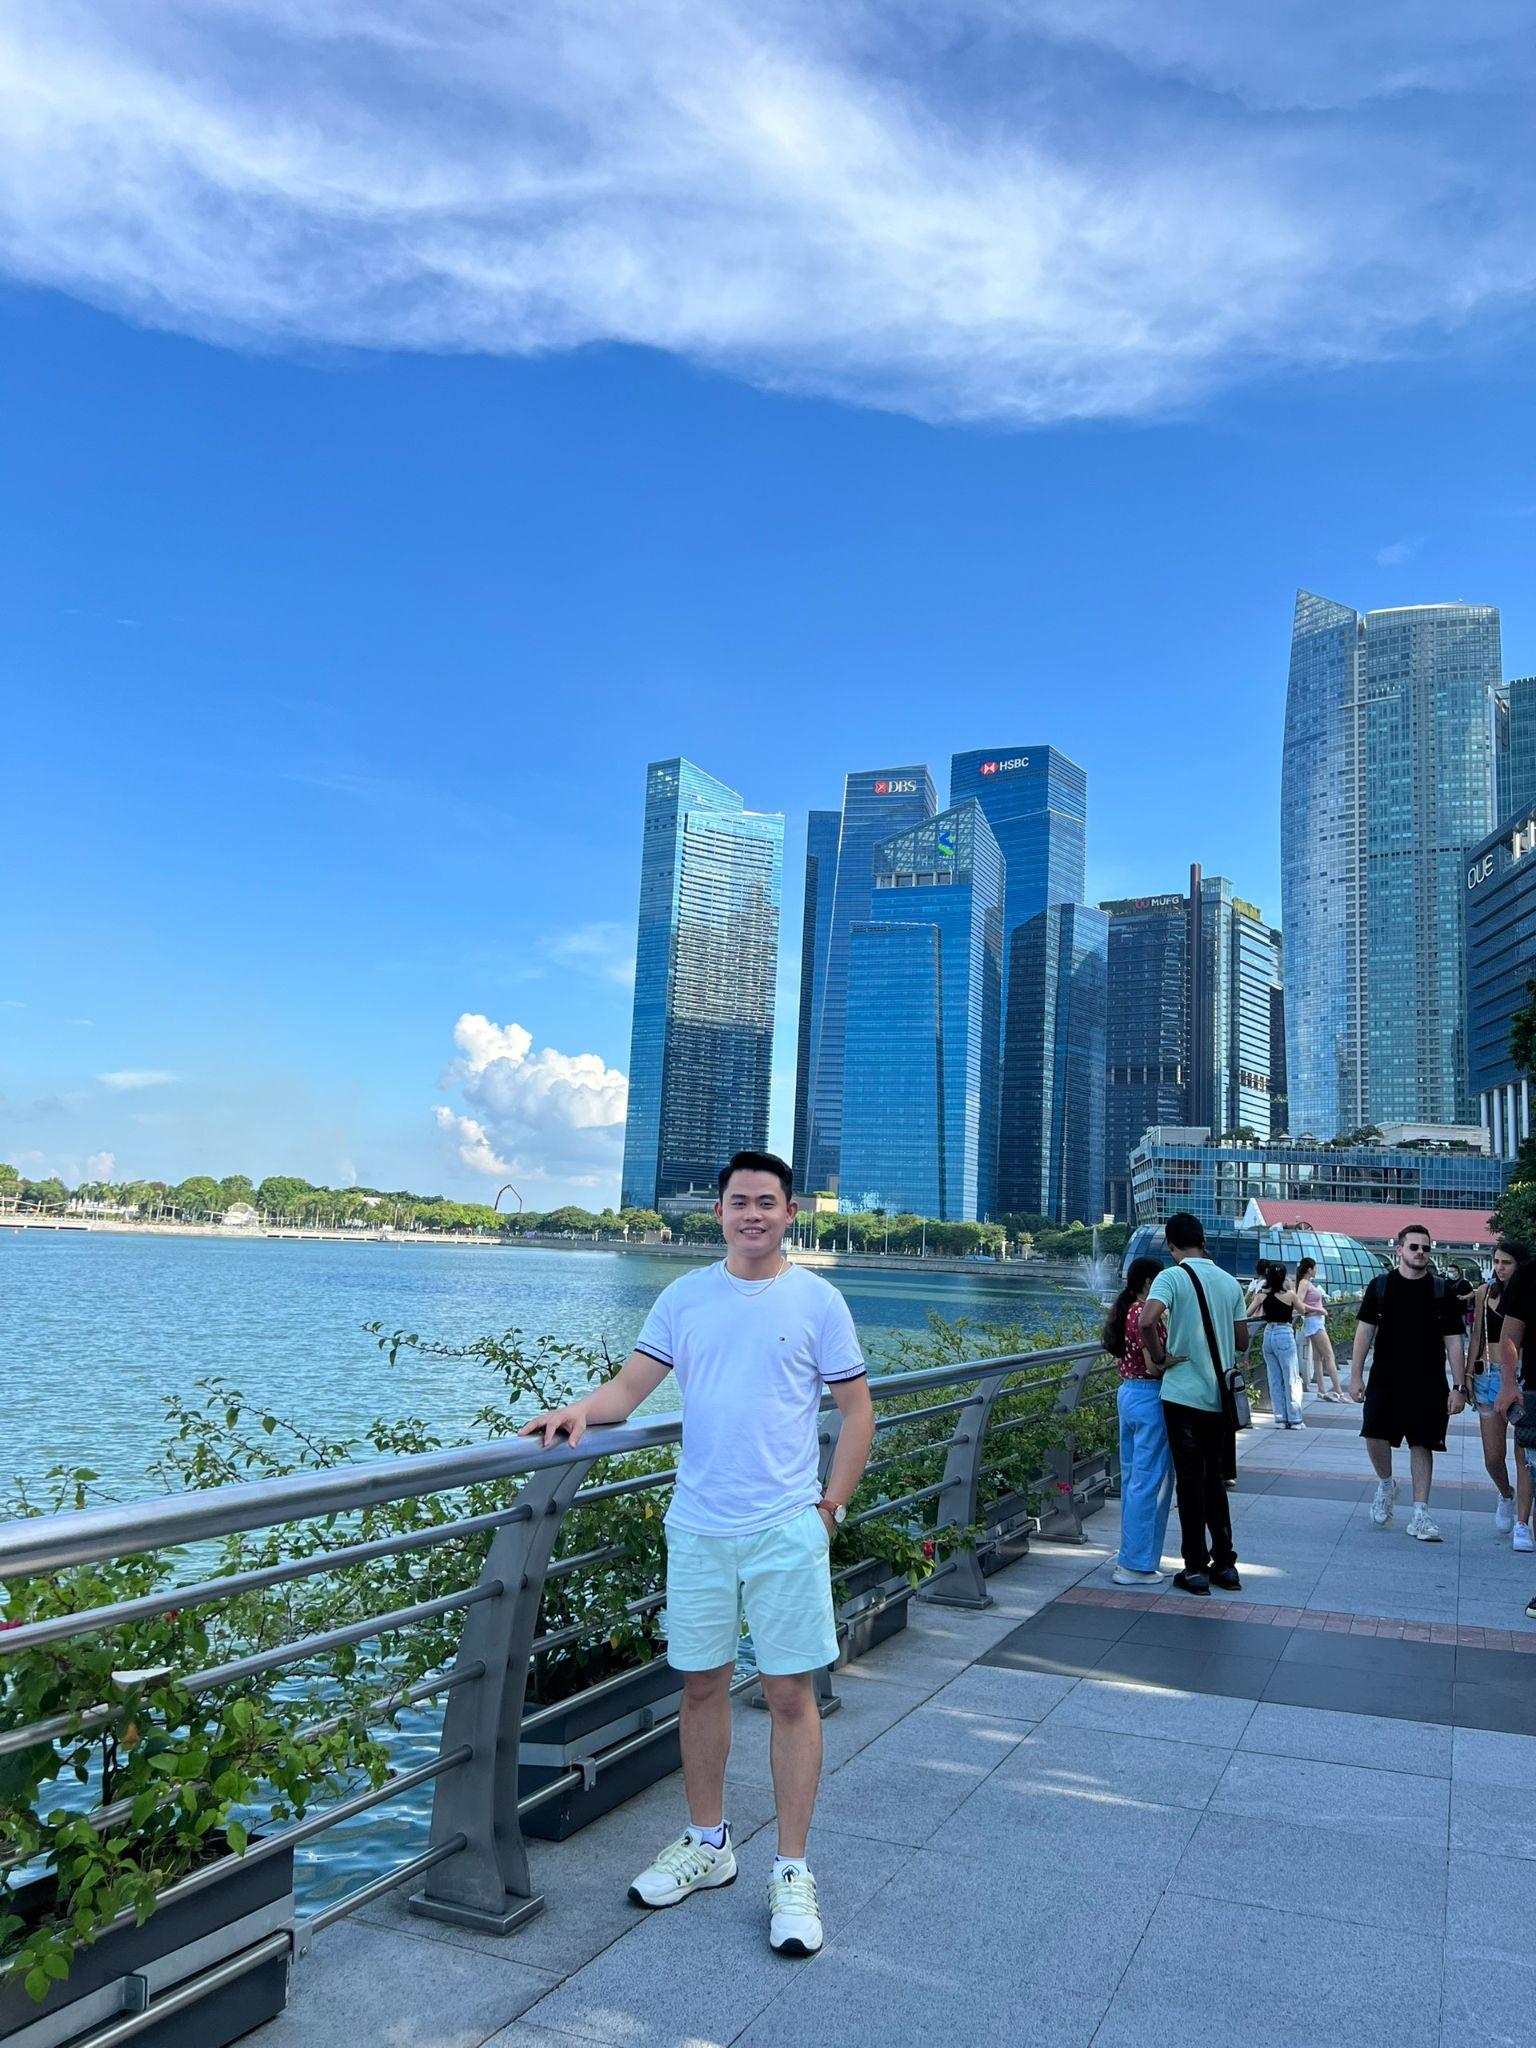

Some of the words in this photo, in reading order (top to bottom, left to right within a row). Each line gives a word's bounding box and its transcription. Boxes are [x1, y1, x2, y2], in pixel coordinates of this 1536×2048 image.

[999, 757, 1030, 771] HSBC
[888, 780, 917, 793] DBS
[1467, 854, 1494, 890] OUE
[1151, 896, 1180, 907] MUFG
